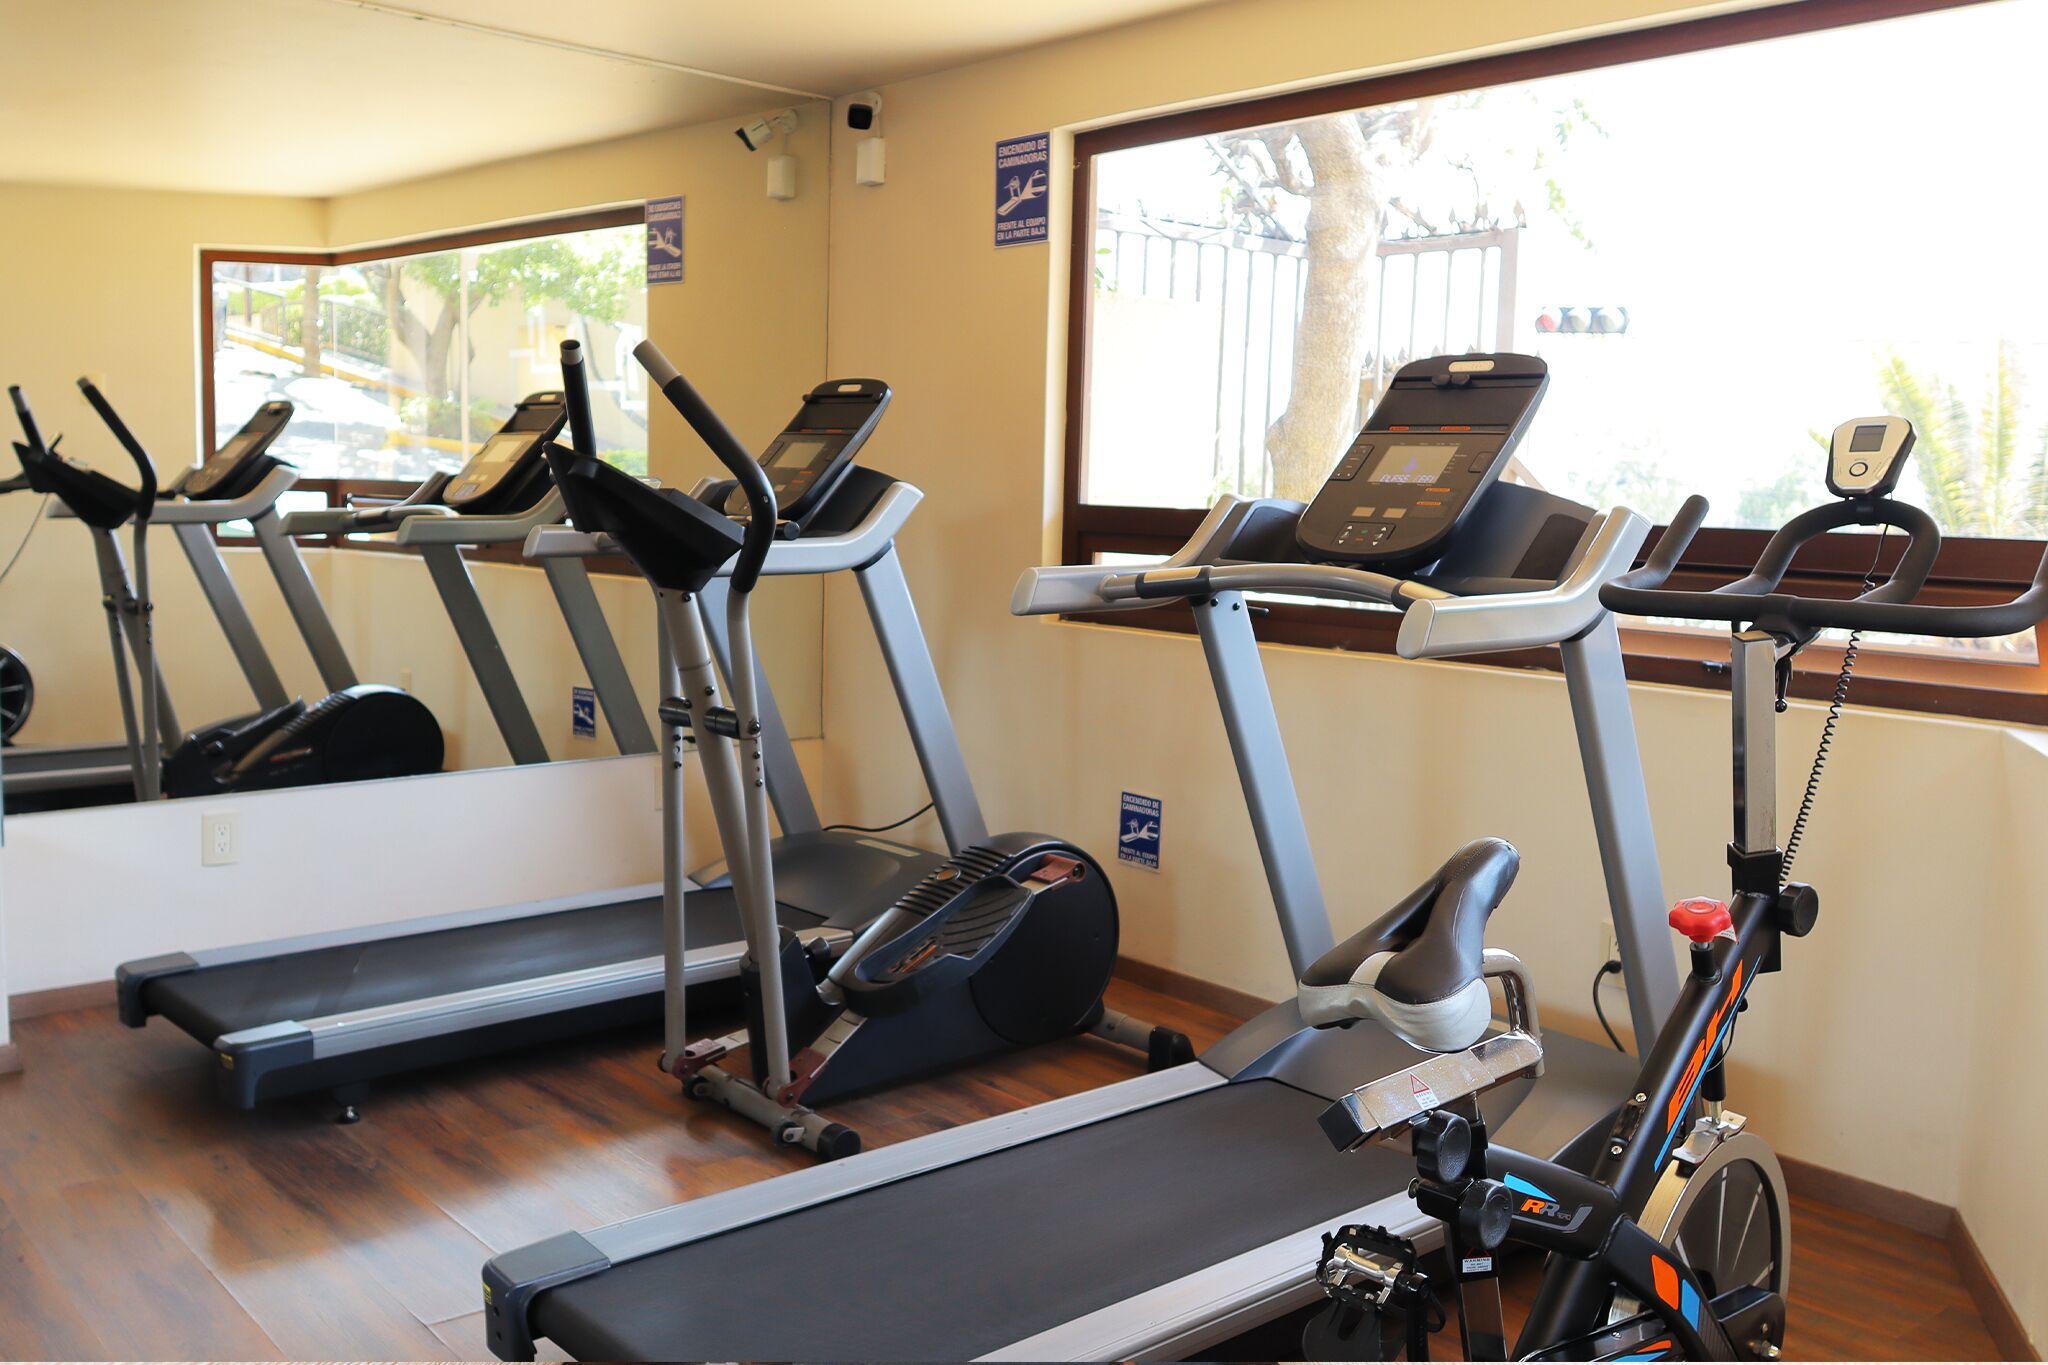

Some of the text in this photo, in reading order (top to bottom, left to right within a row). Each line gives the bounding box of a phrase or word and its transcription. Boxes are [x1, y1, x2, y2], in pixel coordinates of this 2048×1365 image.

[998, 138, 1047, 157] ENCENDIDO DE
[998, 151, 1047, 169] CAMINADORAS
[1018, 220, 1025, 228] AL
[1026, 217, 1046, 227] EQUIPO
[997, 231, 1004, 240] EN
[1031, 226, 1046, 236] BAJA
[1152, 801, 1160, 809] DE
